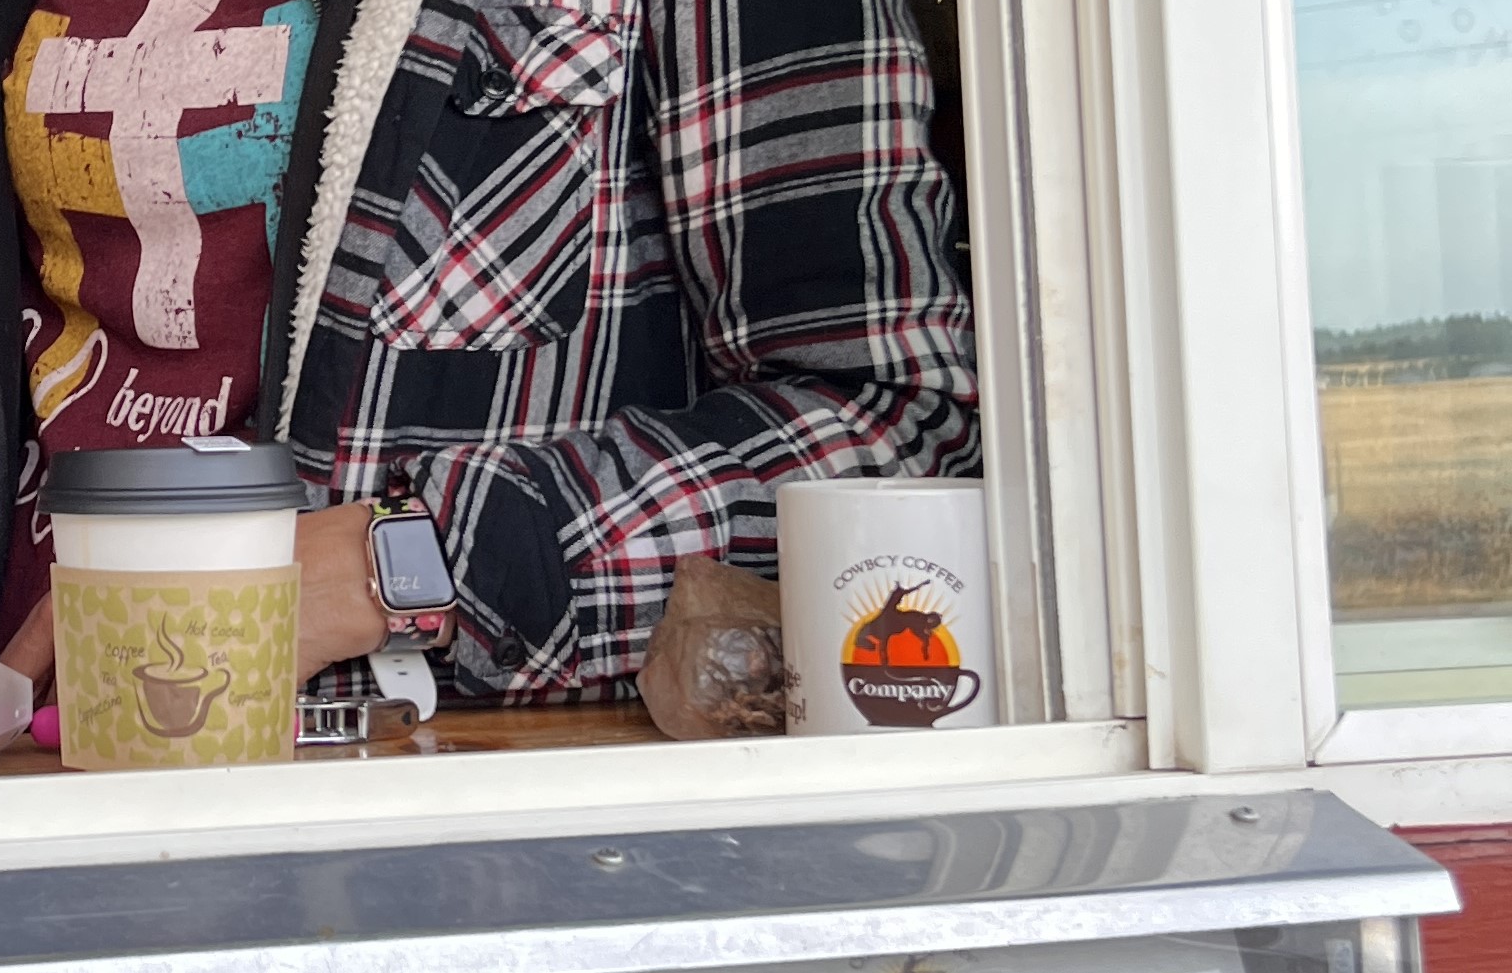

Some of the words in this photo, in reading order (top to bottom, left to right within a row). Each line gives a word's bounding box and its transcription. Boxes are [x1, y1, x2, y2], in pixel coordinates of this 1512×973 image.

[106, 367, 233, 442] beyond
[902, 555, 965, 594] COFFEE
[185, 619, 208, 636] Hot
[104, 642, 146, 666] Coffee
[208, 651, 230, 667] Tea
[100, 671, 117, 687] Tea
[848, 677, 953, 703] Company
